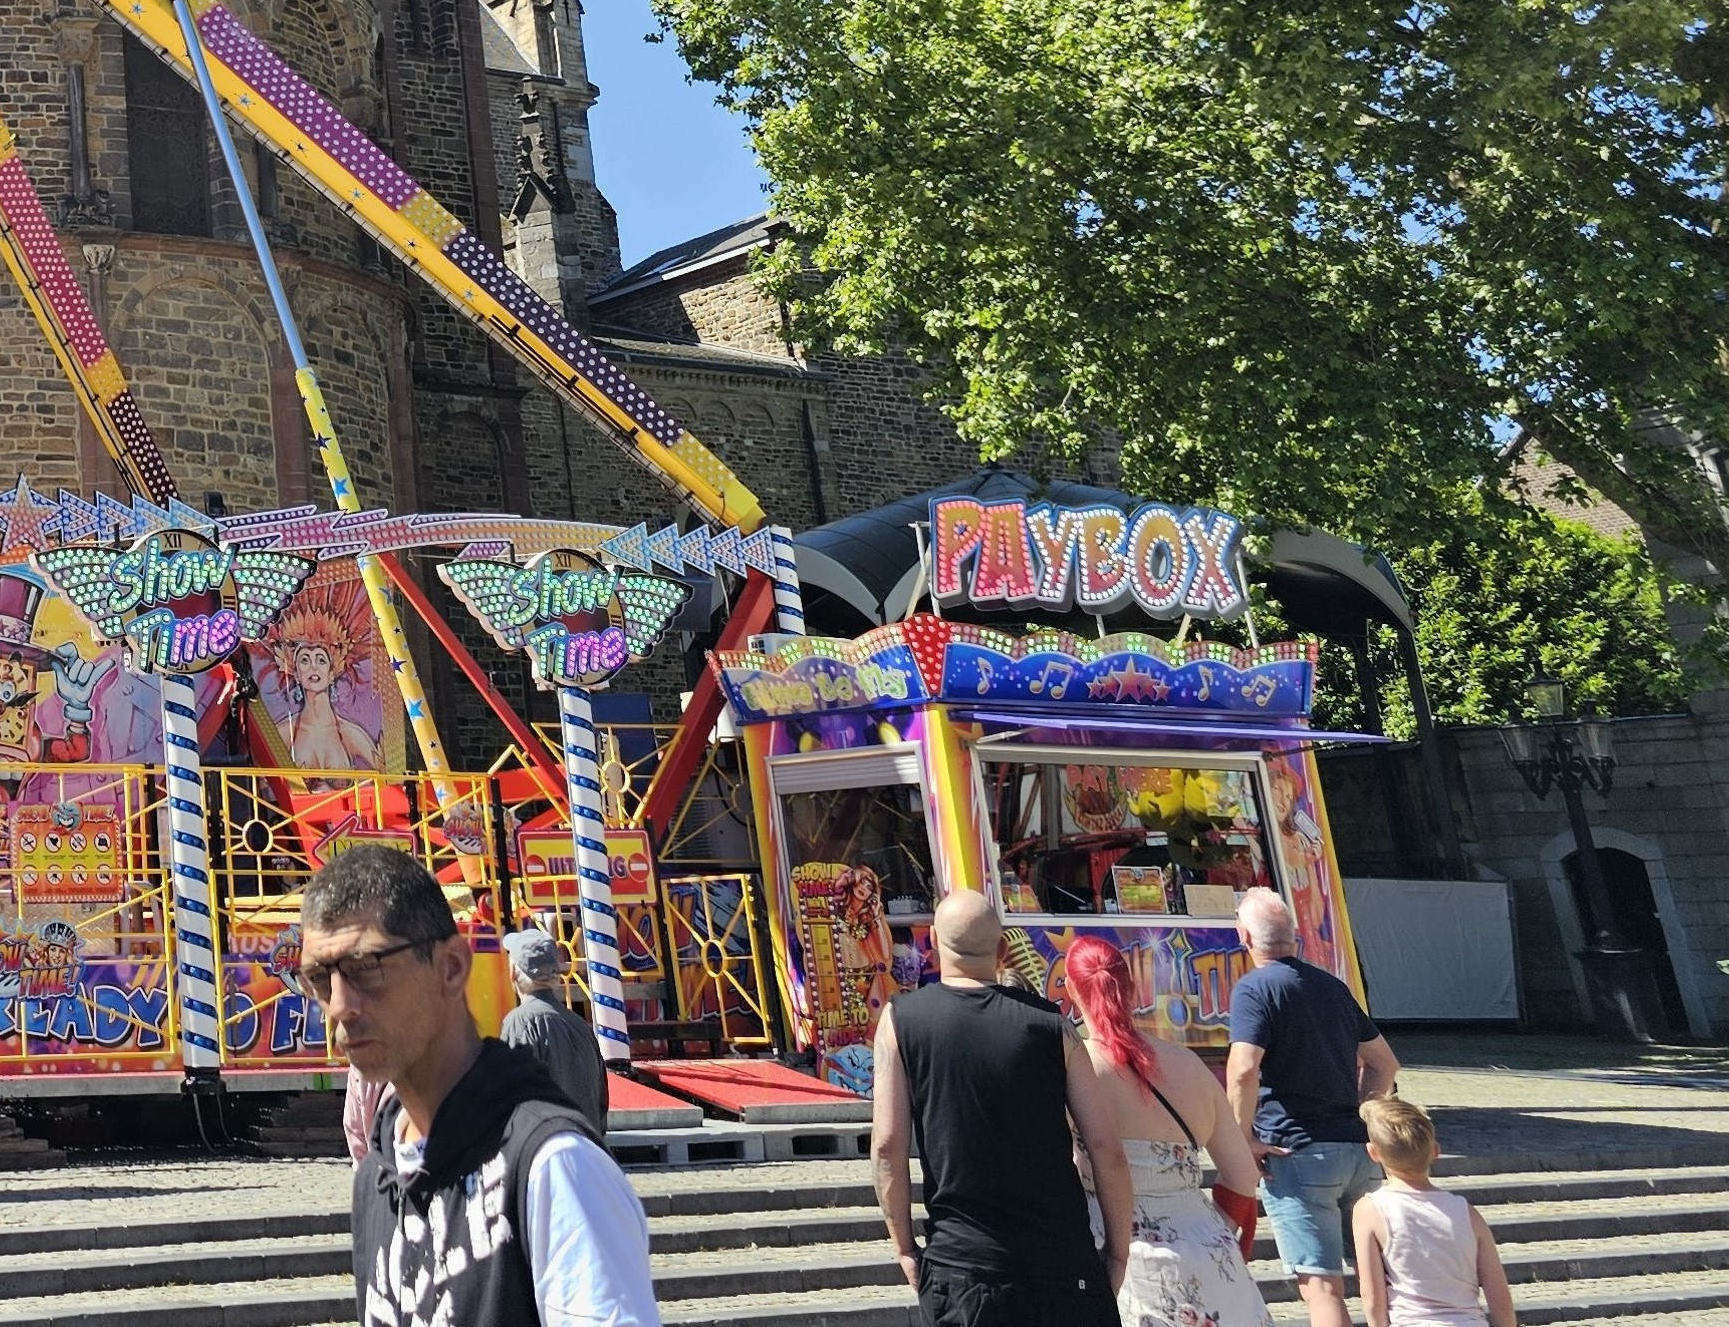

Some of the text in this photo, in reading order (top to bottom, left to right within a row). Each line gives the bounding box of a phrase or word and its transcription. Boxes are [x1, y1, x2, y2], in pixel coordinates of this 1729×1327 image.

[108, 538, 241, 614] Show
[929, 495, 1247, 619] PAYBOX
[509, 557, 621, 626] Show
[124, 608, 241, 673] Time
[524, 622, 629, 682] Time
[548, 855, 628, 879] UITG
[18, 964, 85, 999] TIME!
[271, 993, 329, 1052] FL
